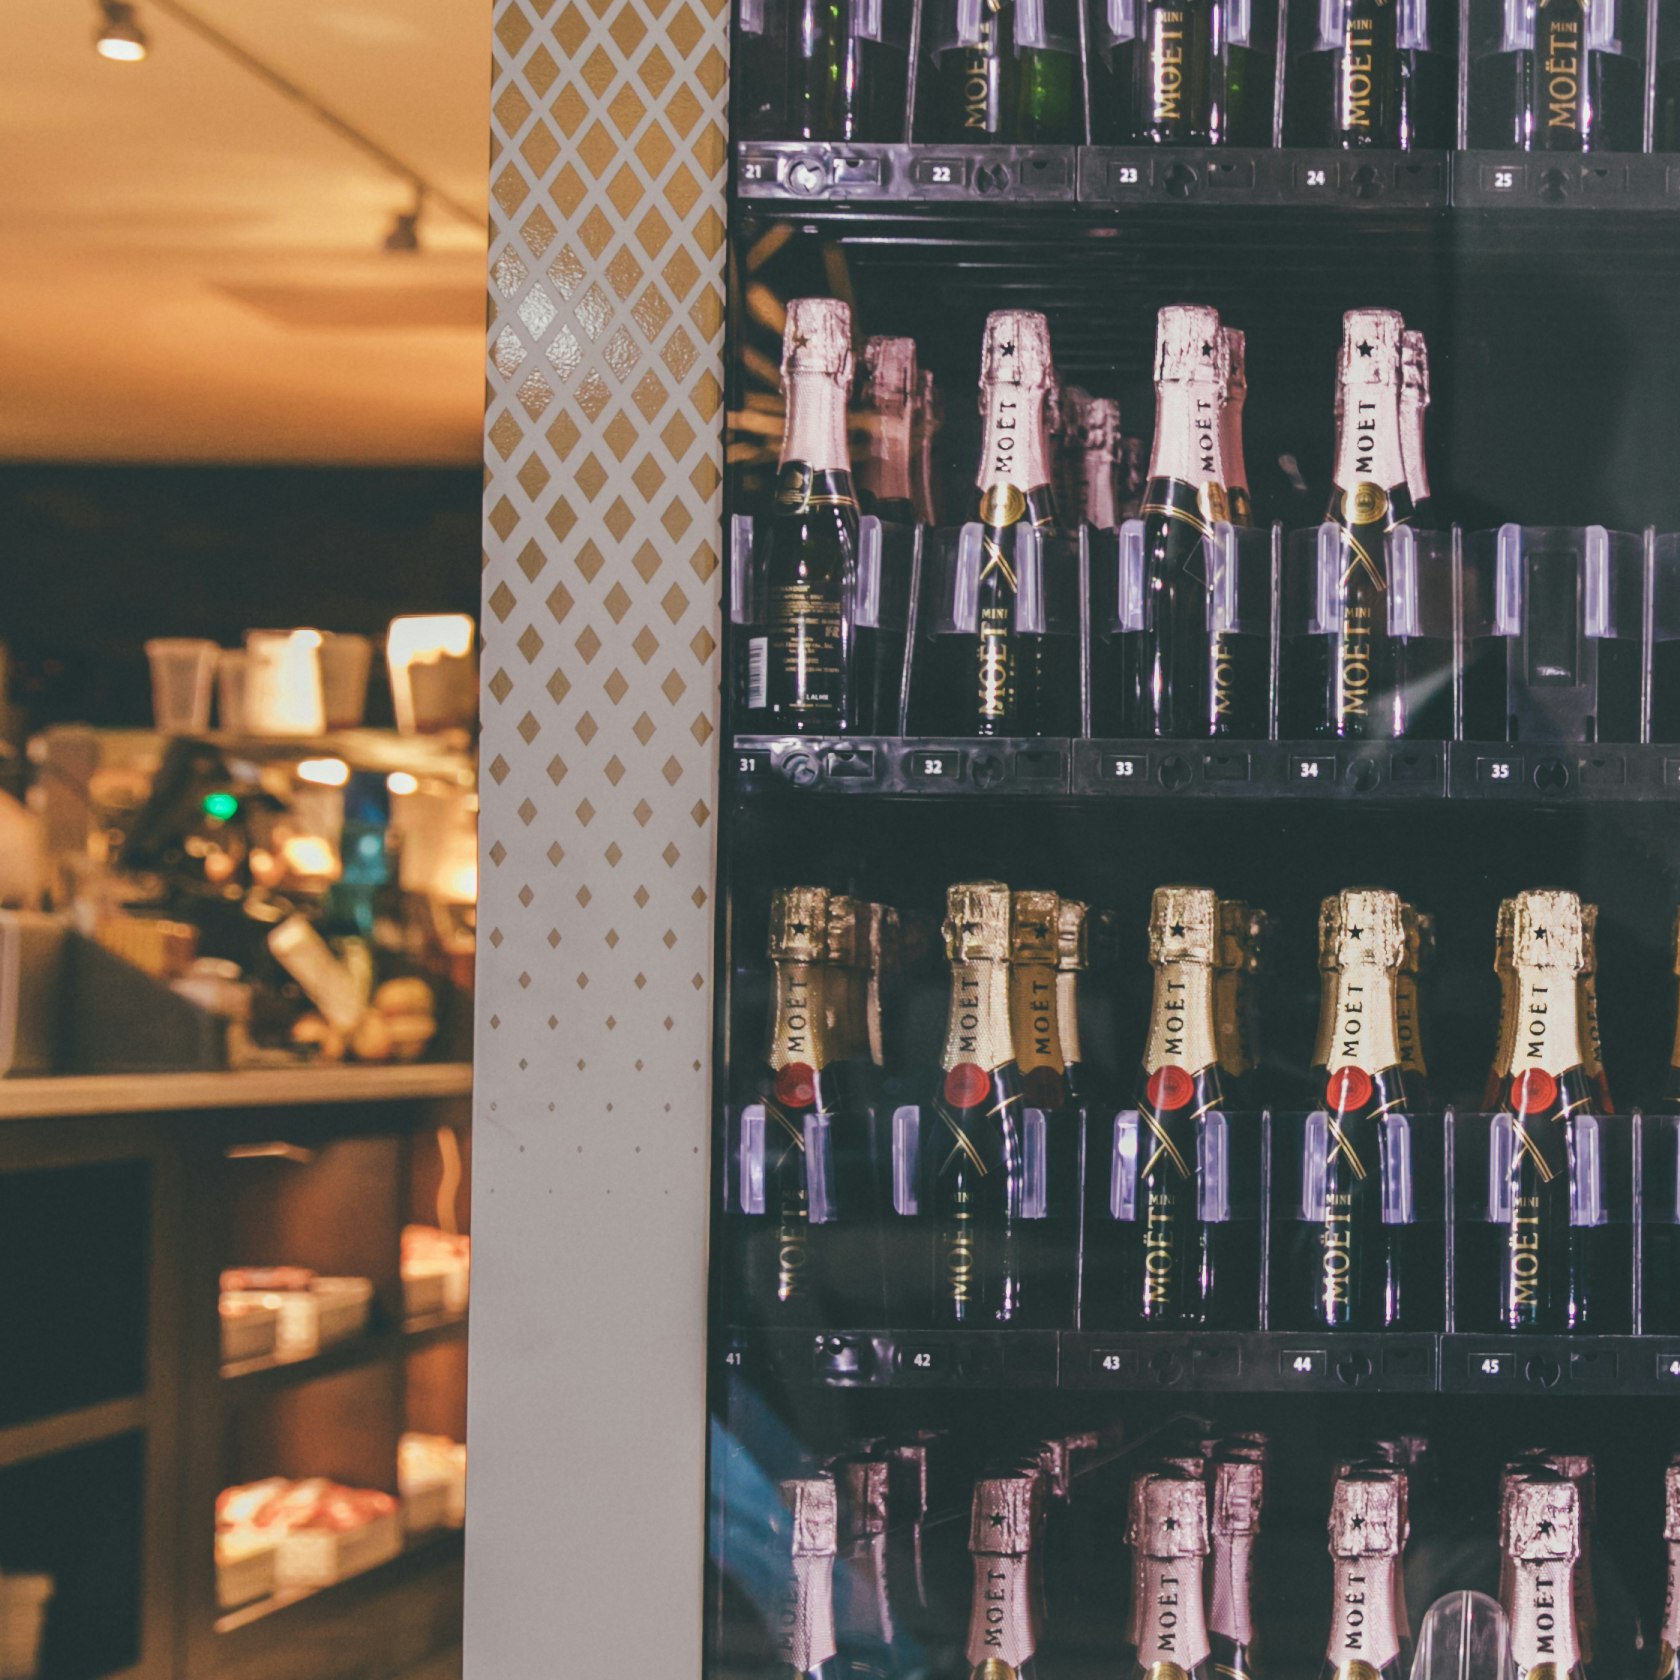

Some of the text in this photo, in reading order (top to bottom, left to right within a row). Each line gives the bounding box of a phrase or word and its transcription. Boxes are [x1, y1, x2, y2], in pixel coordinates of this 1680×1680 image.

[1549, 21, 1577, 34] MINI
[1544, 34, 1577, 129] MOËT
[745, 165, 761, 179] 21
[933, 167, 950, 182] 22
[1120, 169, 1138, 183] 23
[1307, 171, 1325, 185] 24
[1495, 173, 1512, 187] 25
[740, 758, 756, 773] 31
[925, 760, 942, 775] 32
[1116, 761, 1133, 776] 33
[1301, 763, 1318, 778] 34
[1492, 764, 1509, 779] 35
[1527, 983, 1549, 1058] MOËT
[726, 1352, 741, 1366] 41
[914, 1353, 931, 1367] 42
[1103, 1355, 1120, 1370] 43
[1294, 1356, 1312, 1371] 44
[1482, 1359, 1499, 1374] 45
[1344, 1572, 1366, 1650] MOËT
